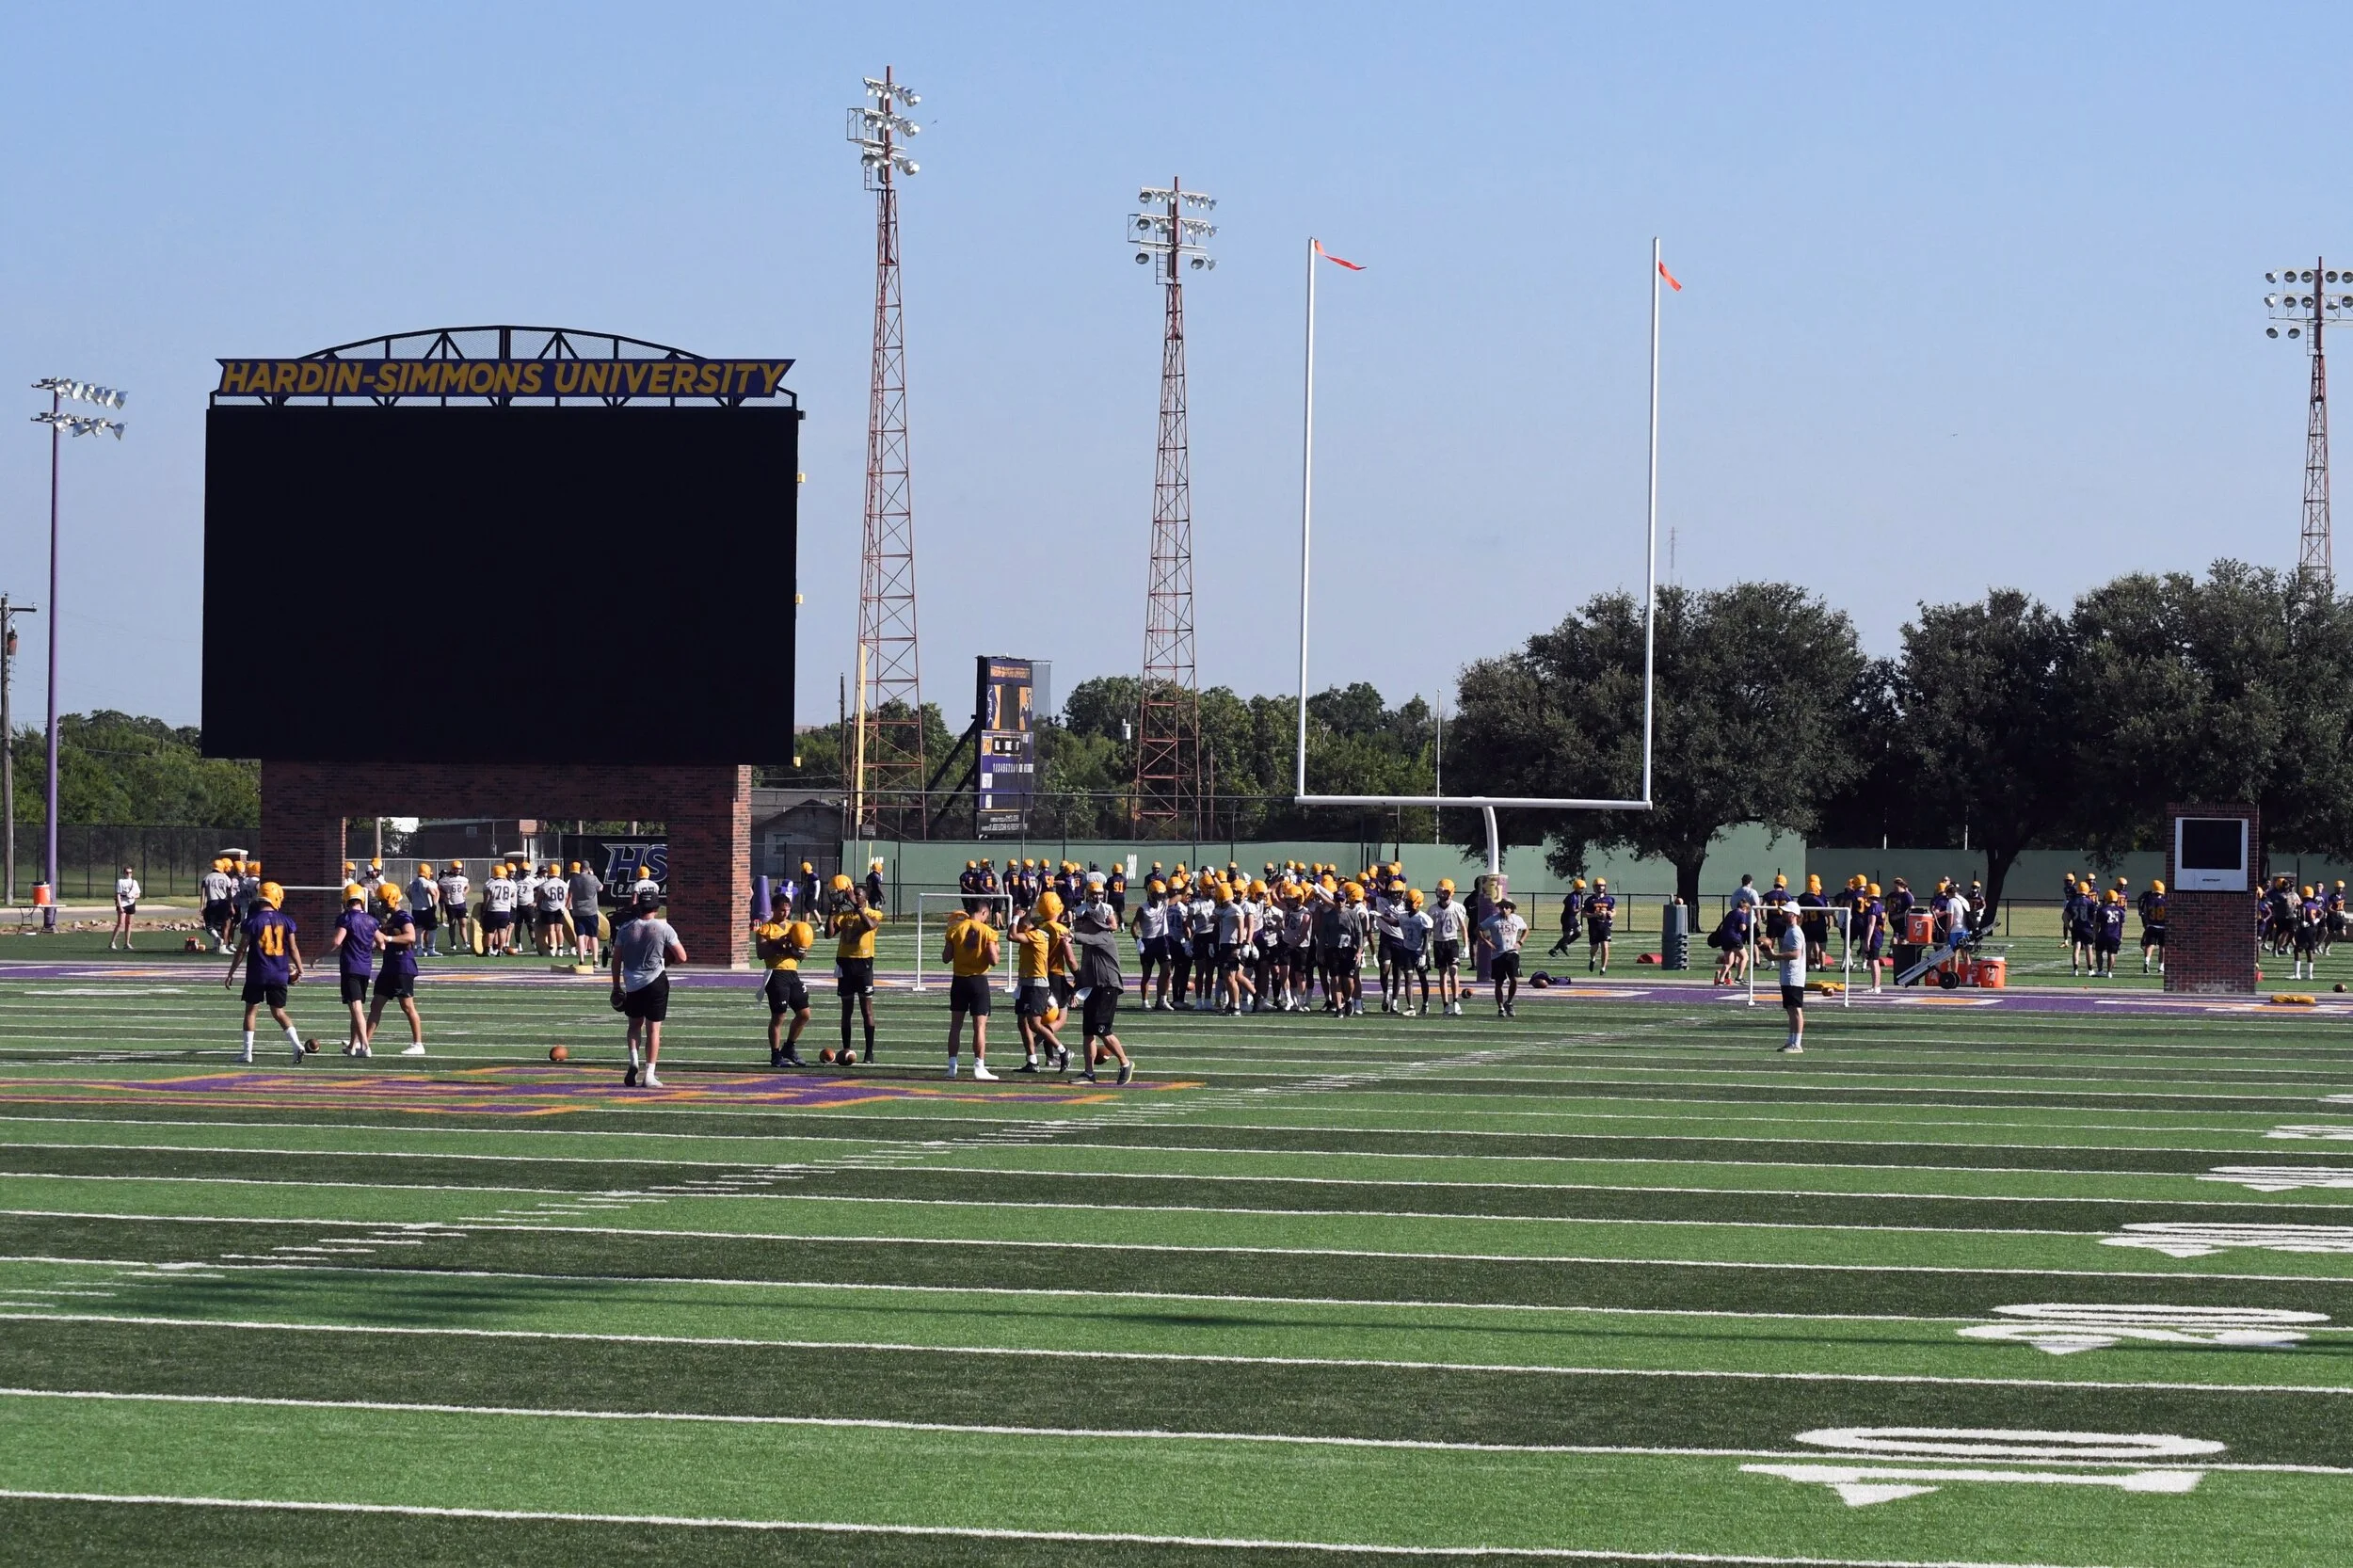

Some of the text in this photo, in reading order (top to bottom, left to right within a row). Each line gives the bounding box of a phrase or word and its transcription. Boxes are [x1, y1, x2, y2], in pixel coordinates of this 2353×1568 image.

[219, 361, 788, 394] HARDIN-SIMMONS UNIVERSITY
[550, 887, 565, 901] 68
[259, 925, 284, 956] 41
[1957, 1303, 2331, 1349] 20
[1739, 1427, 2226, 1493] 10
